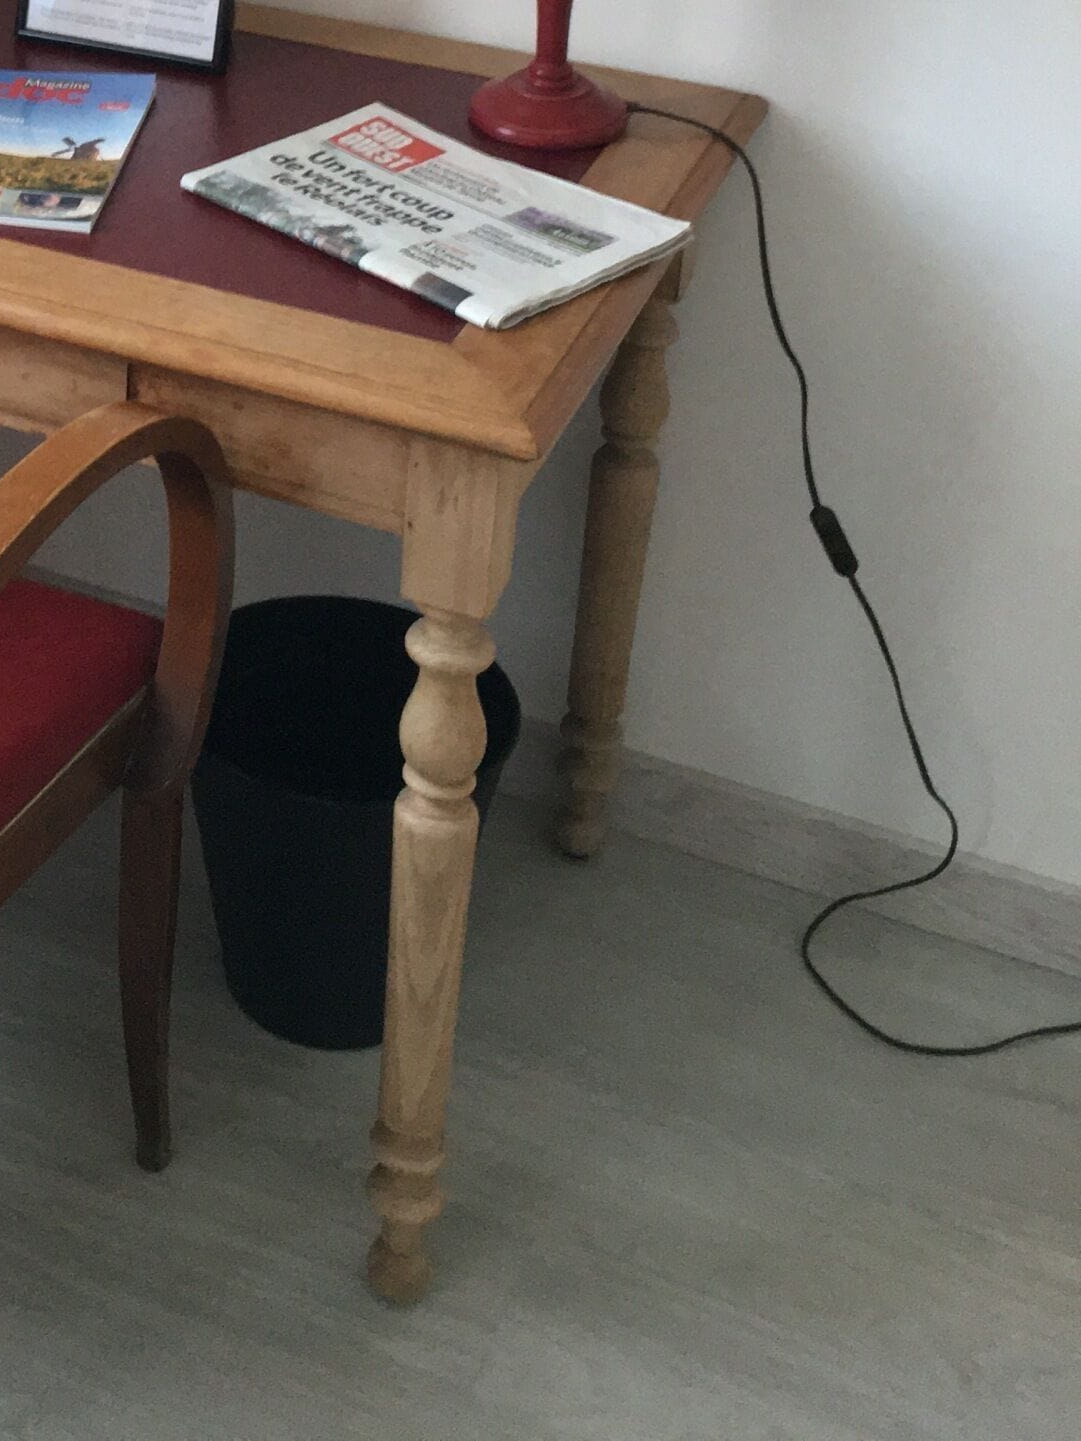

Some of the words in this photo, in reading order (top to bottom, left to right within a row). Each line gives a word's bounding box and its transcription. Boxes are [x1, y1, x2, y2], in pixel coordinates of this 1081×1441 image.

[24, 78, 90, 91] Magazine
[337, 132, 416, 169] OUEST
[360, 121, 413, 149] SUD
[270, 154, 305, 171] de
[302, 169, 361, 196] vent
[357, 193, 443, 234] frappe
[271, 172, 298, 185] le
[308, 150, 346, 172] Un
[342, 170, 395, 193] fort
[389, 192, 454, 221] coup
